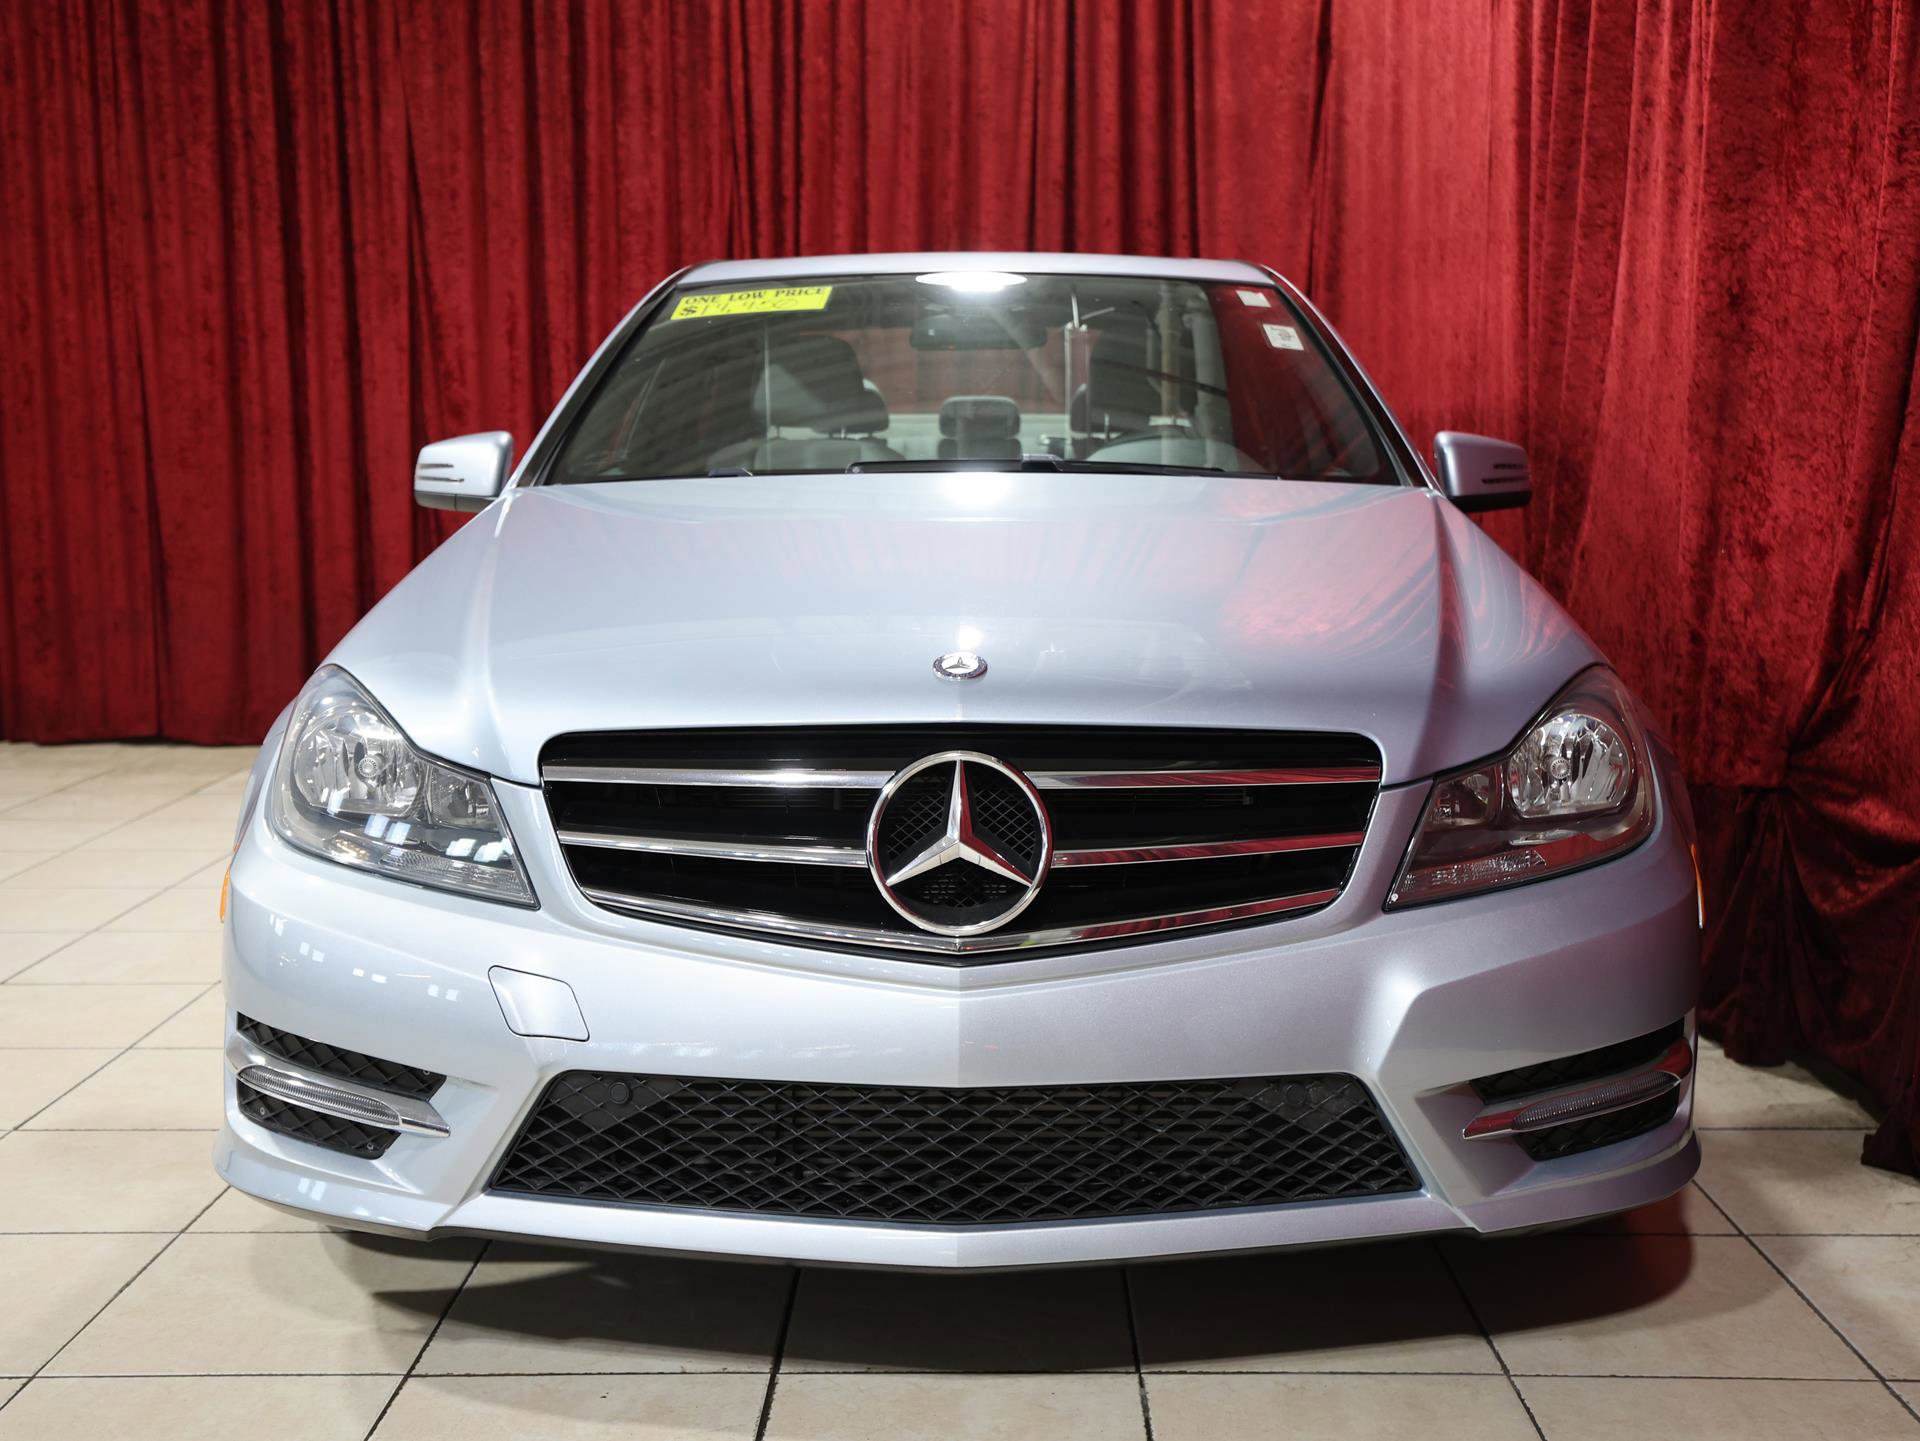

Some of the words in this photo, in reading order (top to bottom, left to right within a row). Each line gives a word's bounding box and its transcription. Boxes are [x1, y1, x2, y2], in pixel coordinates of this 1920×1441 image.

[684, 294, 721, 305] ONE
[729, 291, 766, 302] LOW
[774, 287, 826, 297] PRICE
